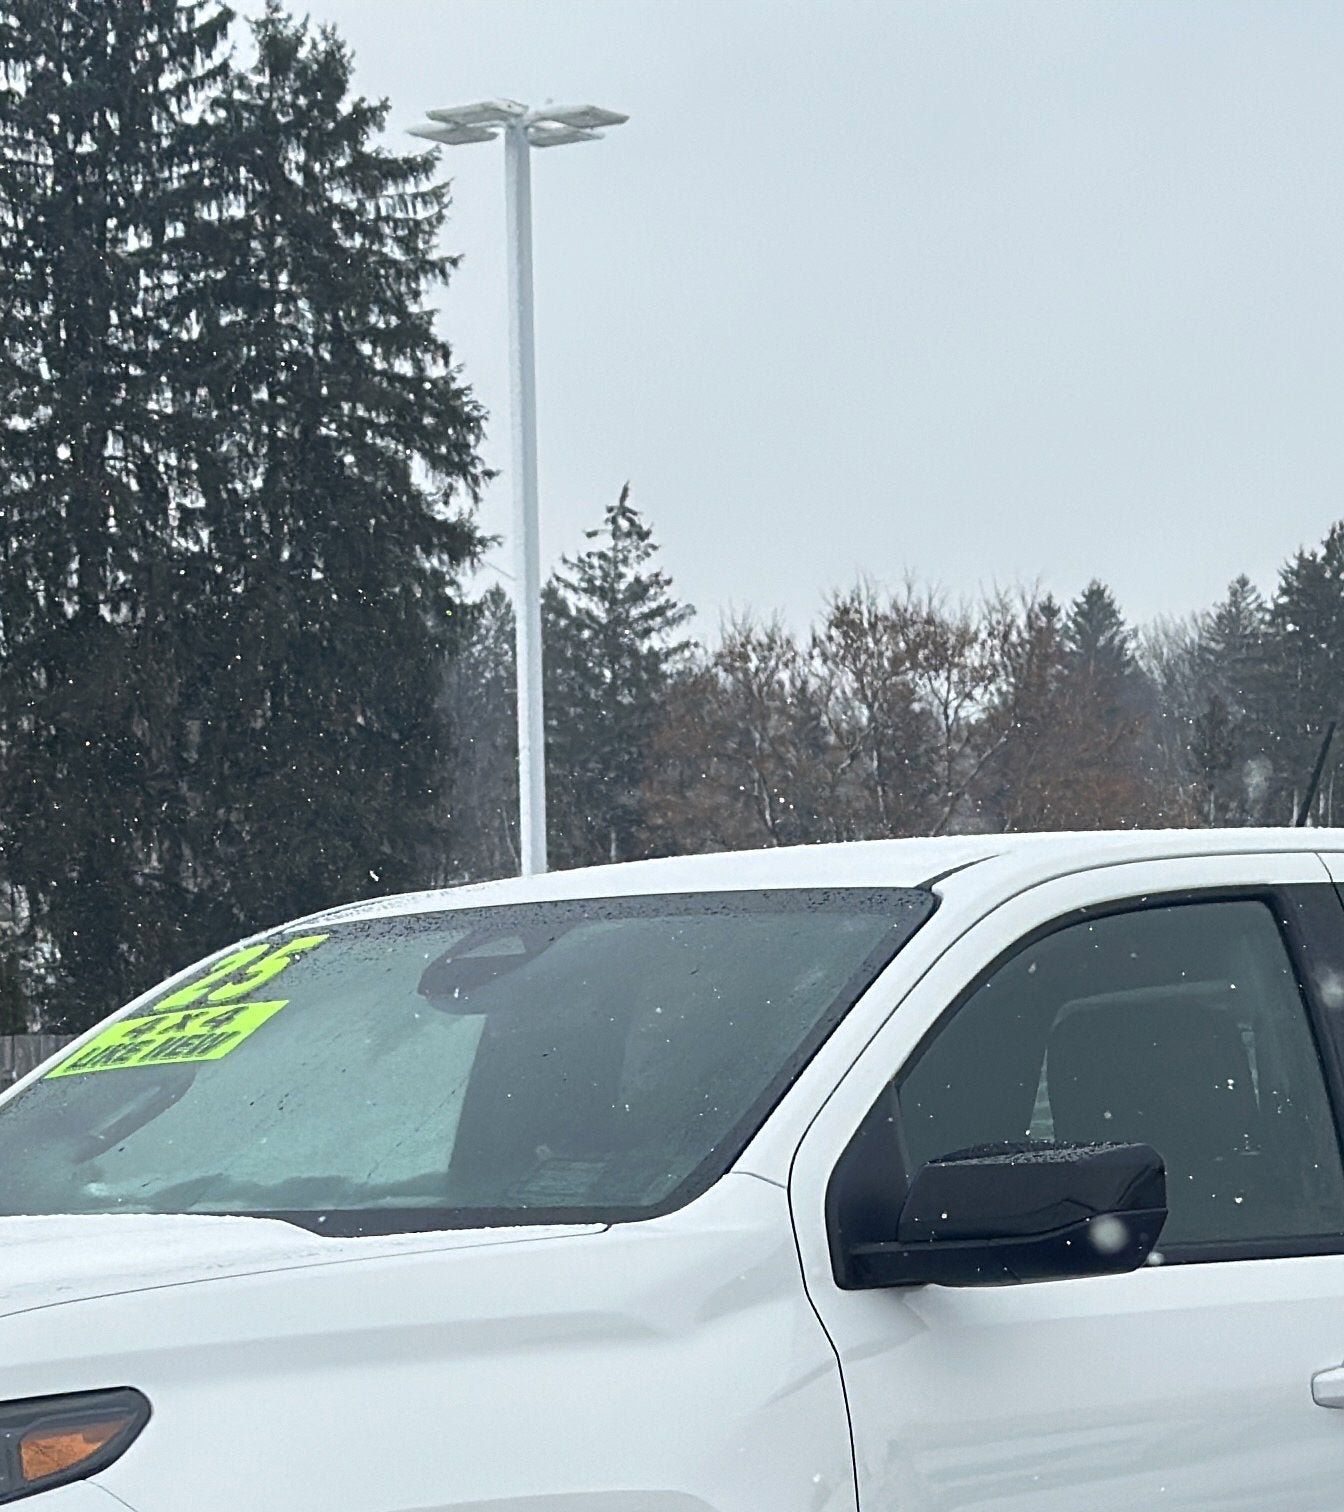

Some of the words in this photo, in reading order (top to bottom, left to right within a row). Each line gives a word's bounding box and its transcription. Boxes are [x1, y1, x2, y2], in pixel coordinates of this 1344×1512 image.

[154, 934, 330, 1012] 25
[63, 1038, 157, 1073] LIKE
[138, 1031, 242, 1063] NEW
